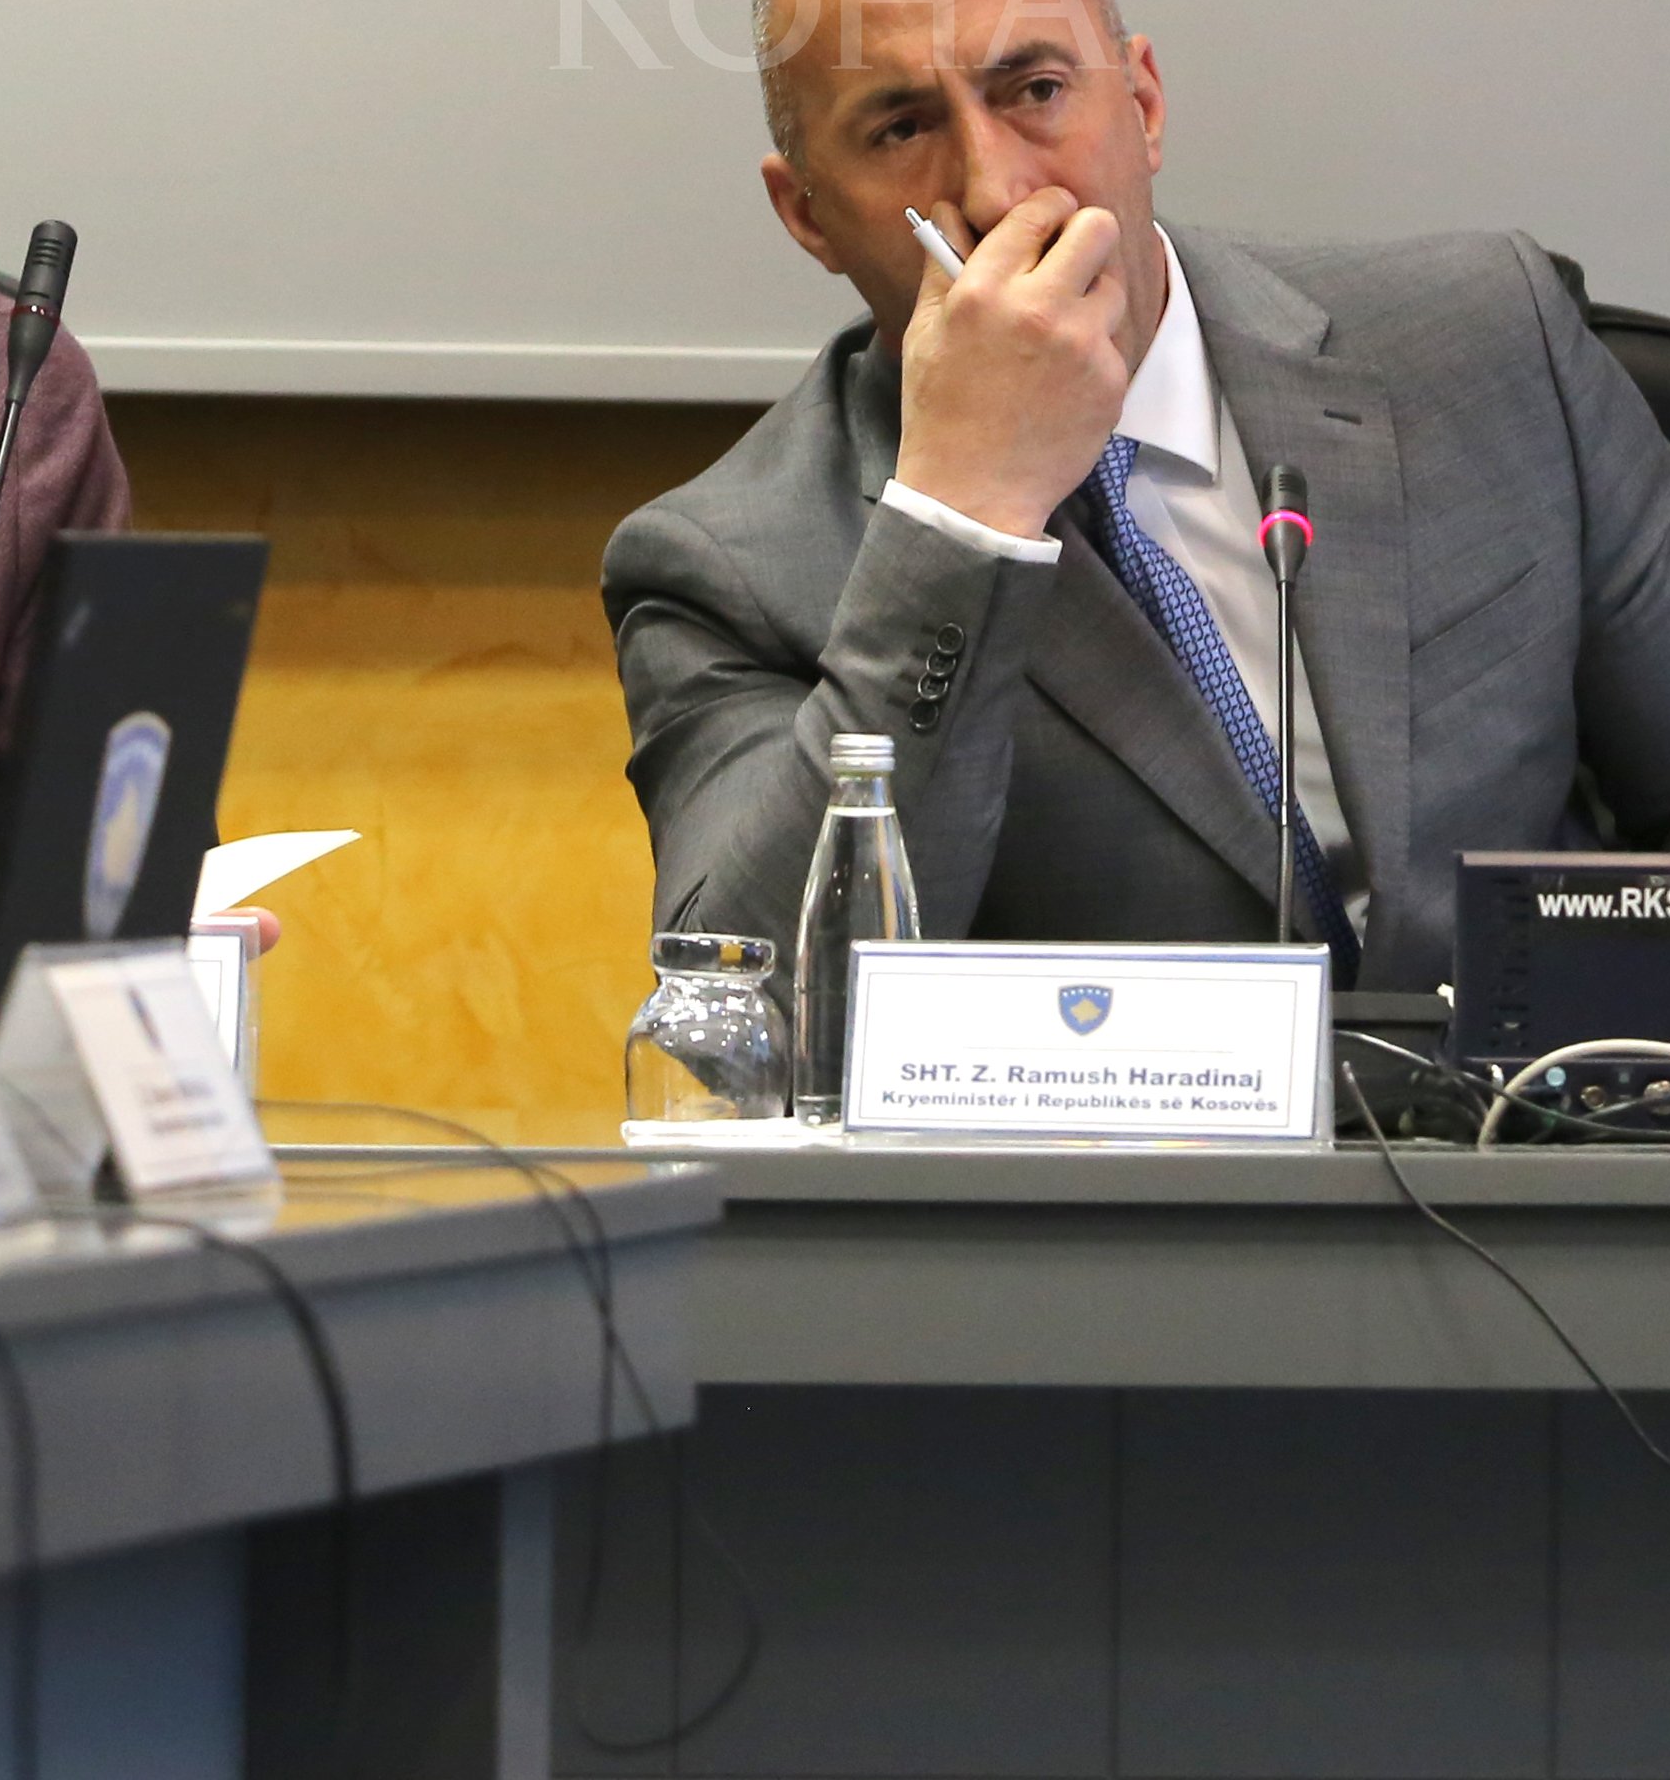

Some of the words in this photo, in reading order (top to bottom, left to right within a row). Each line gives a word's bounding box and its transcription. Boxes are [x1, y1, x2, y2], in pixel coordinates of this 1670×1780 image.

[900, 1063, 961, 1082] SHT.
[971, 1064, 996, 1083] Z.
[1007, 1065, 1118, 1085] Ramush
[1128, 1067, 1263, 1092] Haradinaj
[882, 1090, 1018, 1109] Kryeministër
[1037, 1093, 1151, 1111] Republikës
[1159, 1097, 1183, 1111] së
[1190, 1096, 1278, 1112] Kosovës
